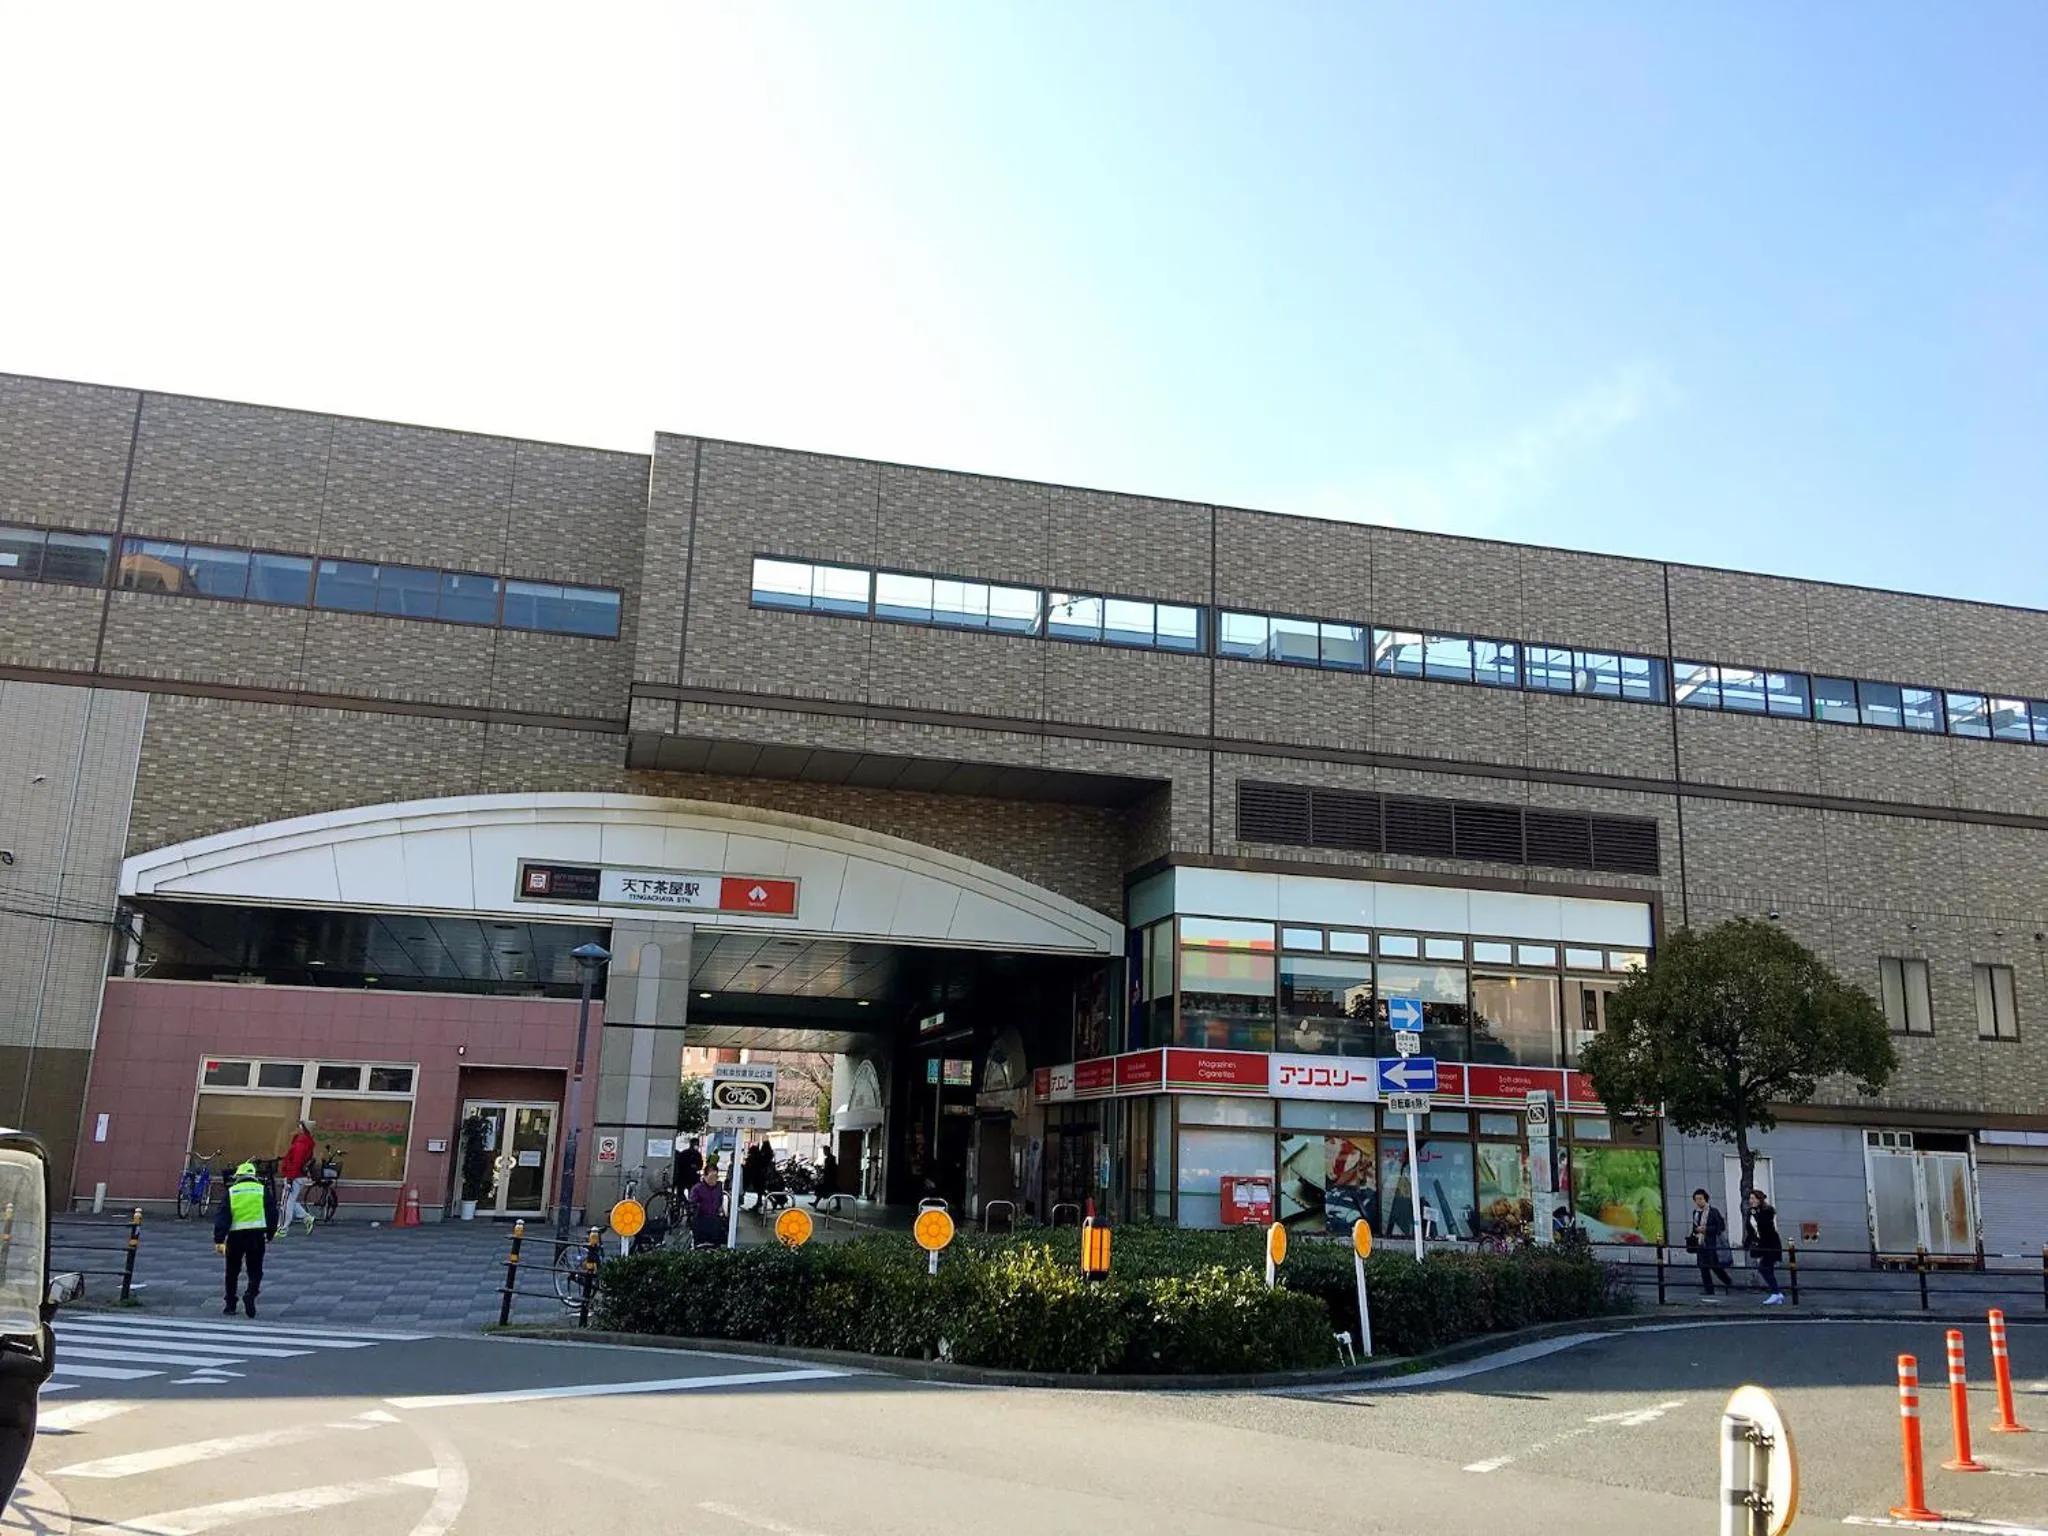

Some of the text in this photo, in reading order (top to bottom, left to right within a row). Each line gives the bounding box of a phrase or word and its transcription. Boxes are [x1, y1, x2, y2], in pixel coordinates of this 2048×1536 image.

[622, 878, 700, 897] 天下茶屋駅
[628, 893, 674, 903] TENGACHAYA
[1198, 1060, 1236, 1069] Magazines
[1198, 1069, 1235, 1079] Cigarettes
[1279, 1065, 1368, 1088] アンスリー
[1391, 1098, 1428, 1109] 自転車を除く
[725, 1115, 756, 1126] 大阪市
